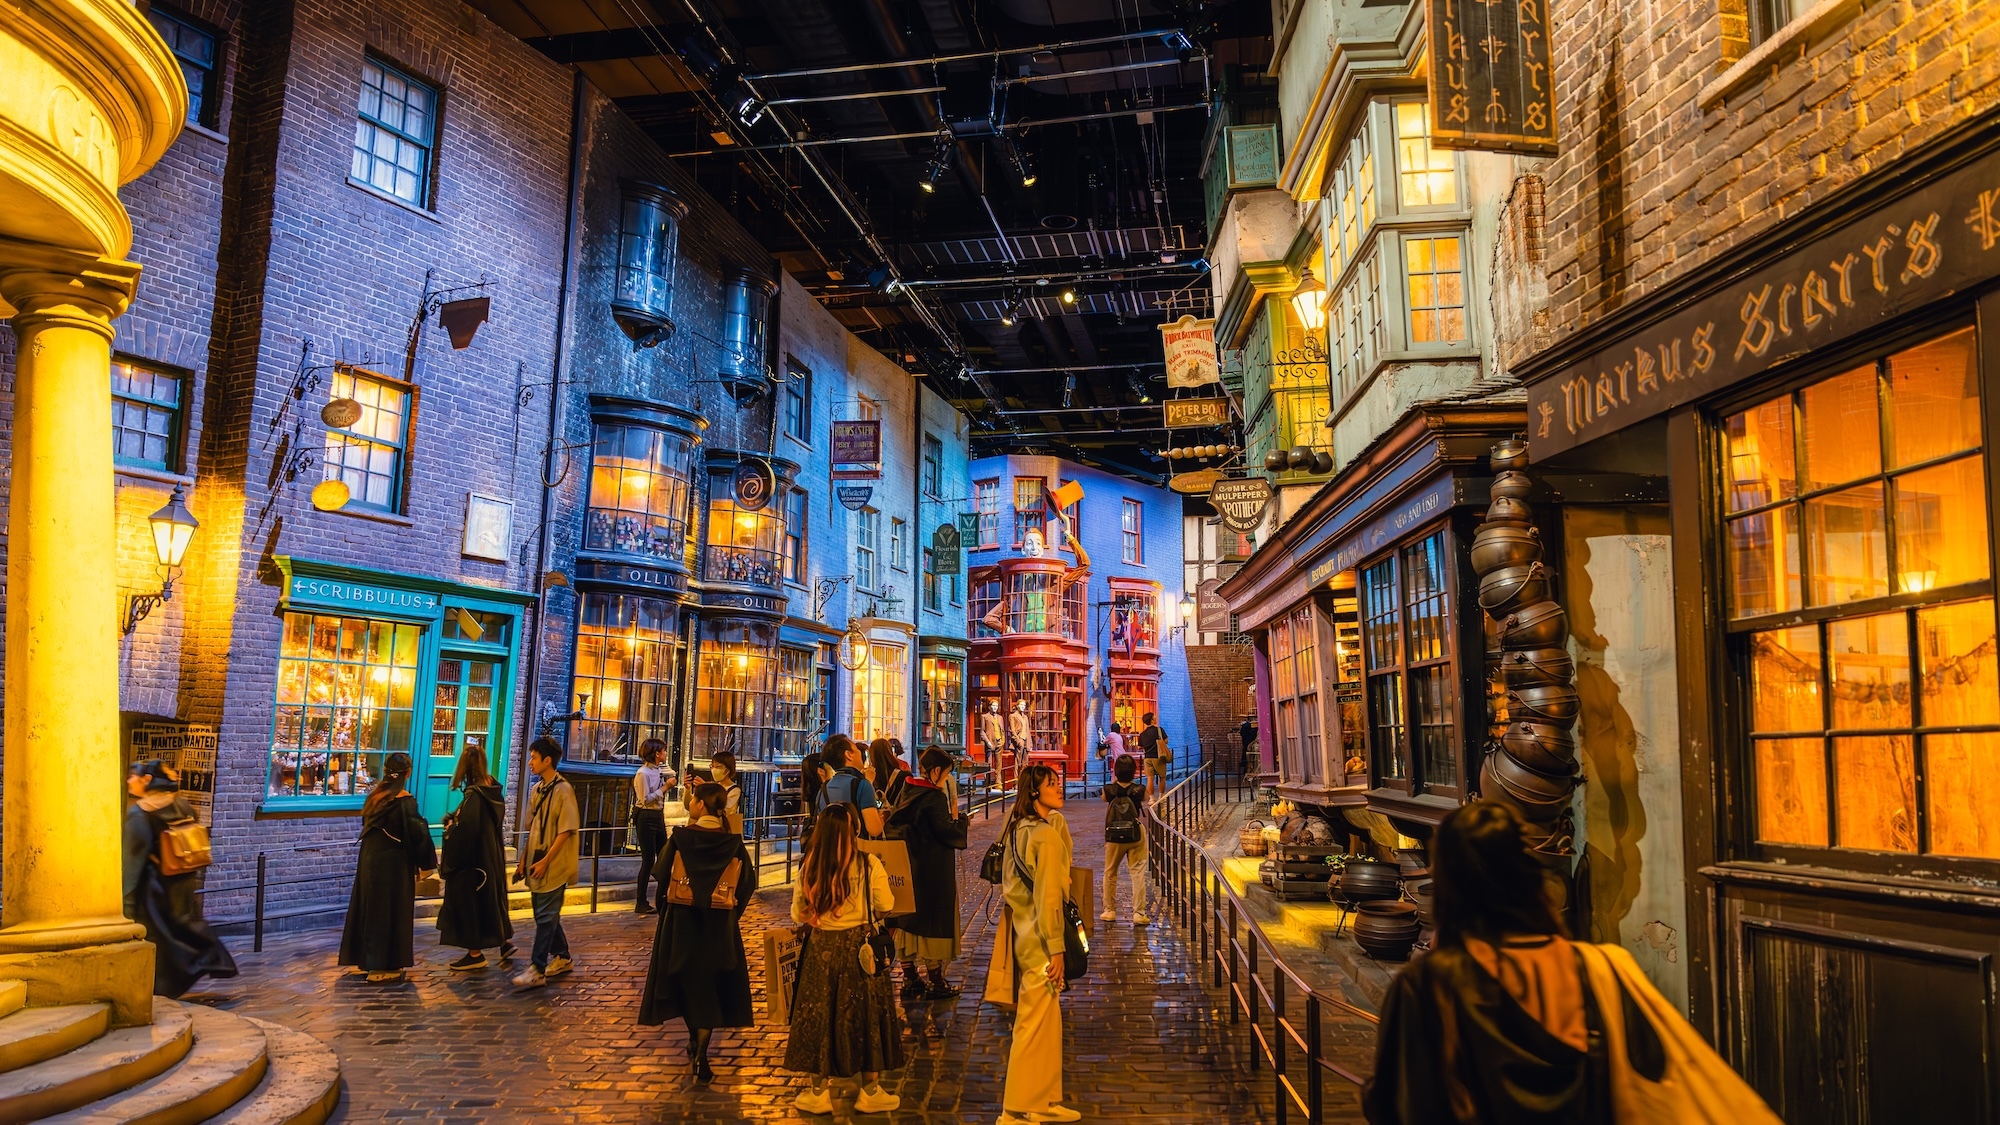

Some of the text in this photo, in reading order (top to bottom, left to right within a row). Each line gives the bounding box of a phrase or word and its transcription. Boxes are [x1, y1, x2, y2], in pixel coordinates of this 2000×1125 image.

[1560, 211, 1943, 435] Markus Scarr's
[1183, 349, 1215, 360] TRIMMING
[1200, 359, 1212, 367] COST
[1169, 404, 1200, 422] PETER
[1233, 484, 1248, 492] MR.
[1215, 490, 1268, 501] MULPEPPER'S
[1408, 502, 1421, 523] AND
[1421, 491, 1439, 513] USED
[1243, 516, 1259, 529] ALLEY
[630, 570, 682, 589] OLLIVA
[308, 581, 422, 608] SCRIBBULUS
[744, 597, 782, 611] OLLIV
[151, 736, 181, 749] WANTED
[184, 734, 215, 748] WANTED
